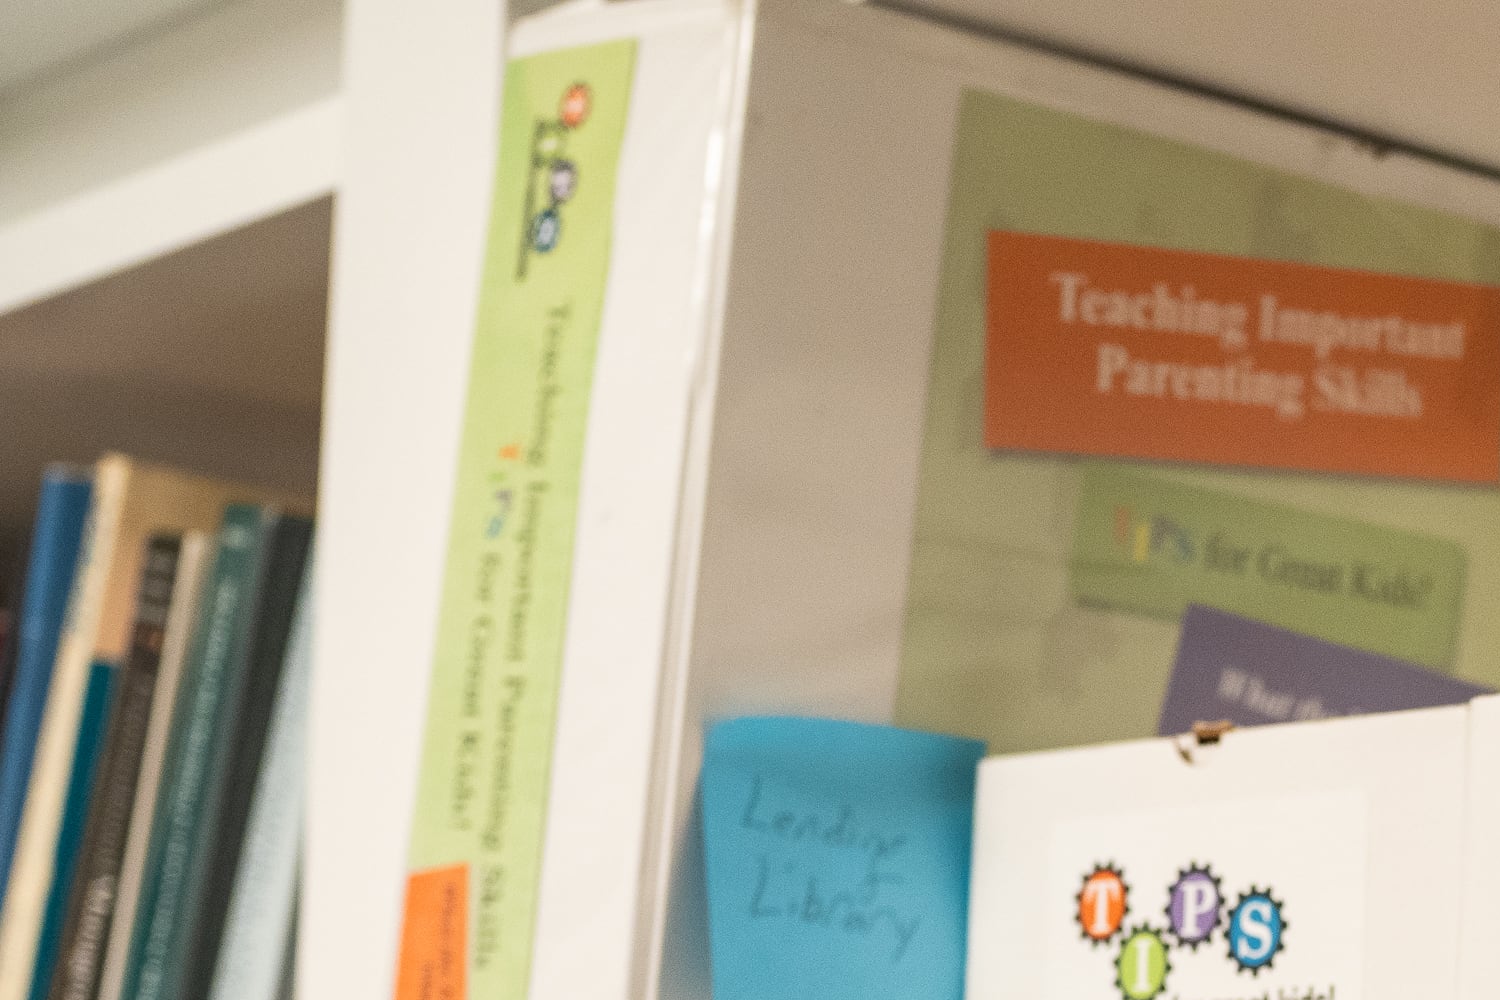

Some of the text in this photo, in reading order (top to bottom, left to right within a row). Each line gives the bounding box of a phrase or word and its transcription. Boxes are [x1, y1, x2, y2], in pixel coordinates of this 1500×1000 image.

[1050, 273, 1465, 360] Teaching Important
[1098, 343, 1423, 420] Parenting Skills
[1205, 532, 1251, 573] for
[751, 857, 921, 960] Library
[1083, 875, 1276, 995] TIPS
